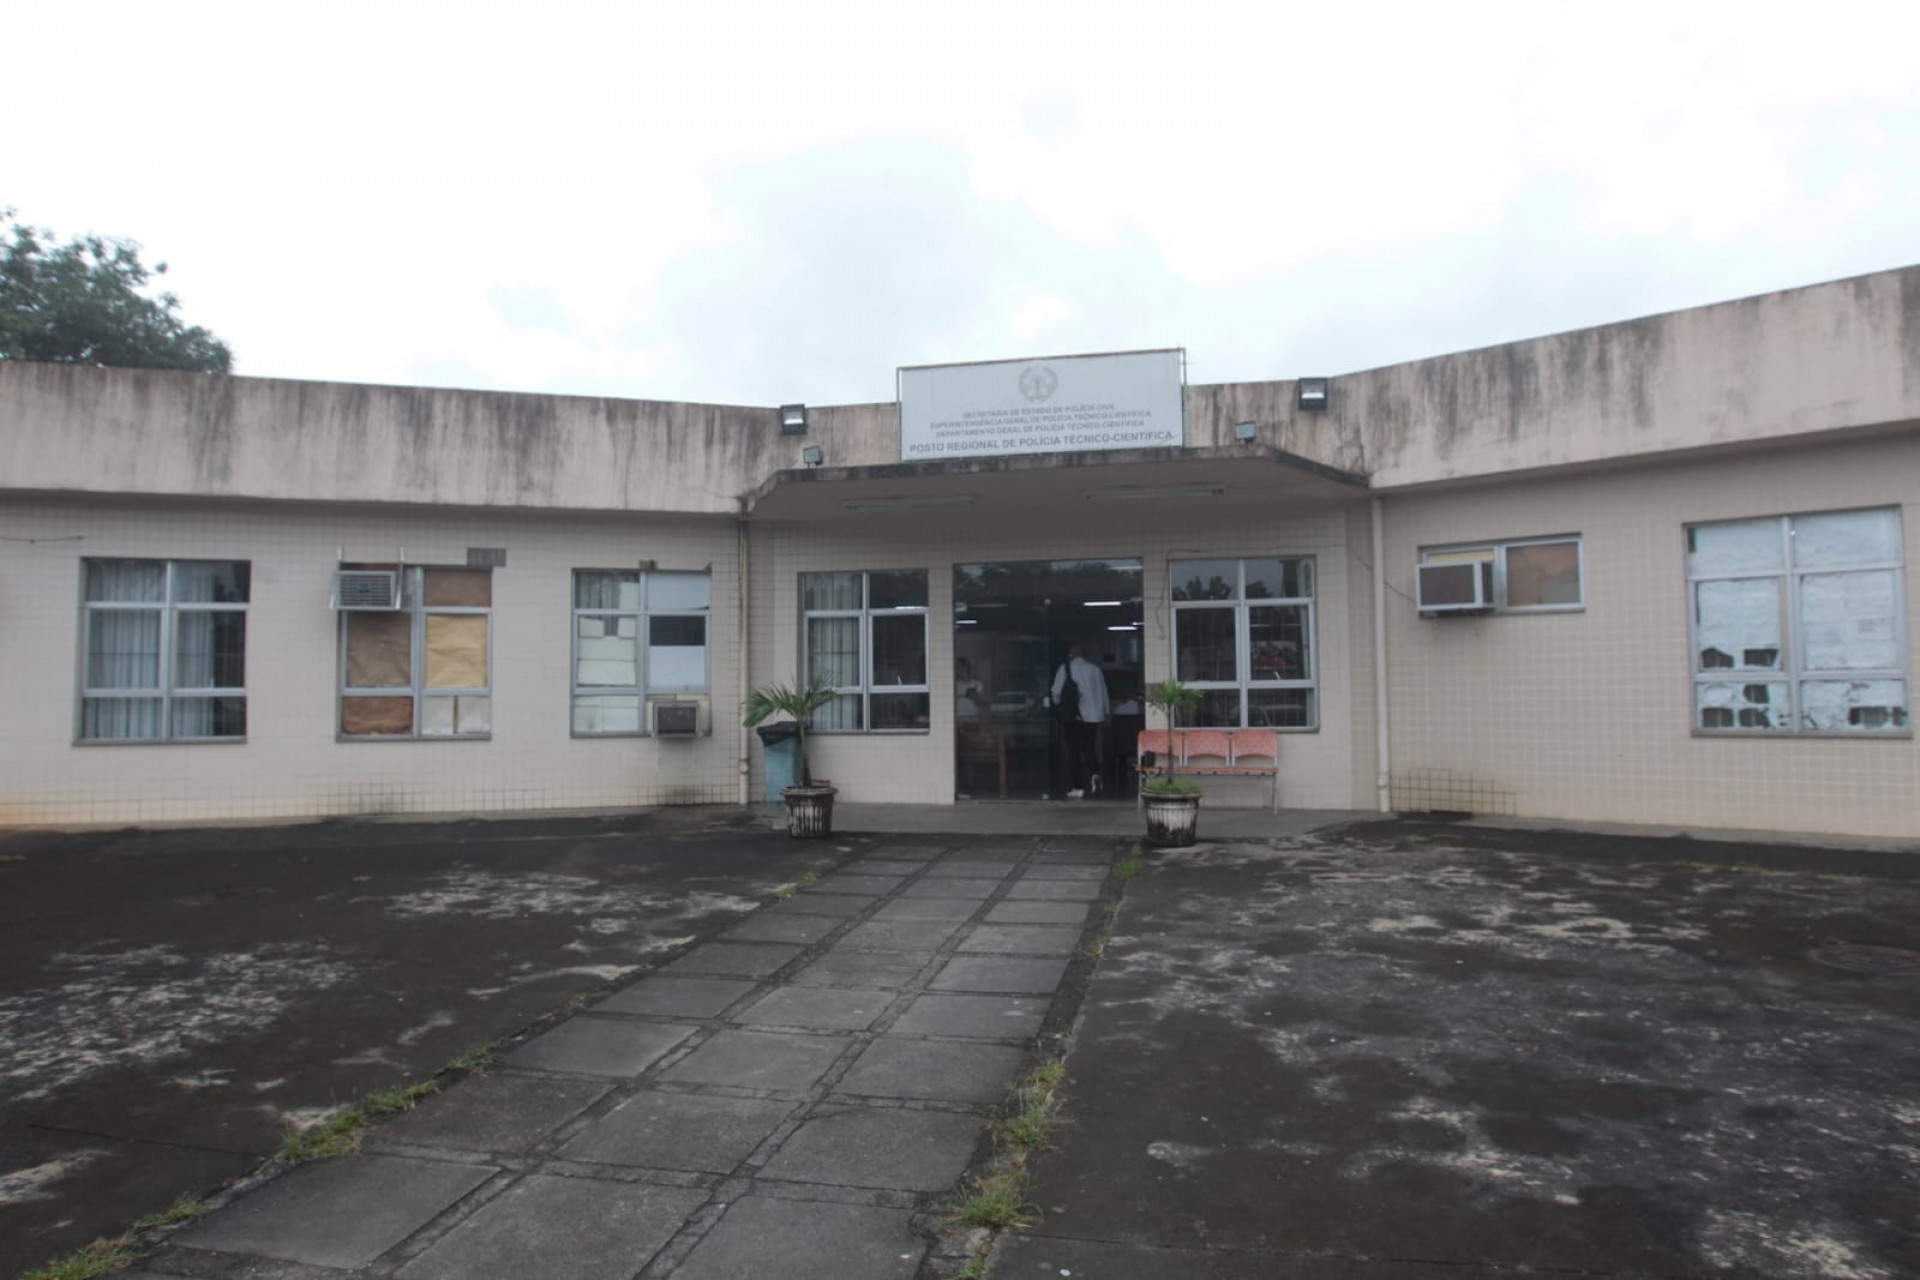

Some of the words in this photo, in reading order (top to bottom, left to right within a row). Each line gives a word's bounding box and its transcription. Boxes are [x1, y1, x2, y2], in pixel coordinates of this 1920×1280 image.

[910, 443, 944, 453] POSTO
[947, 440, 999, 451] REGIONAL
[1002, 438, 1016, 448] DE
